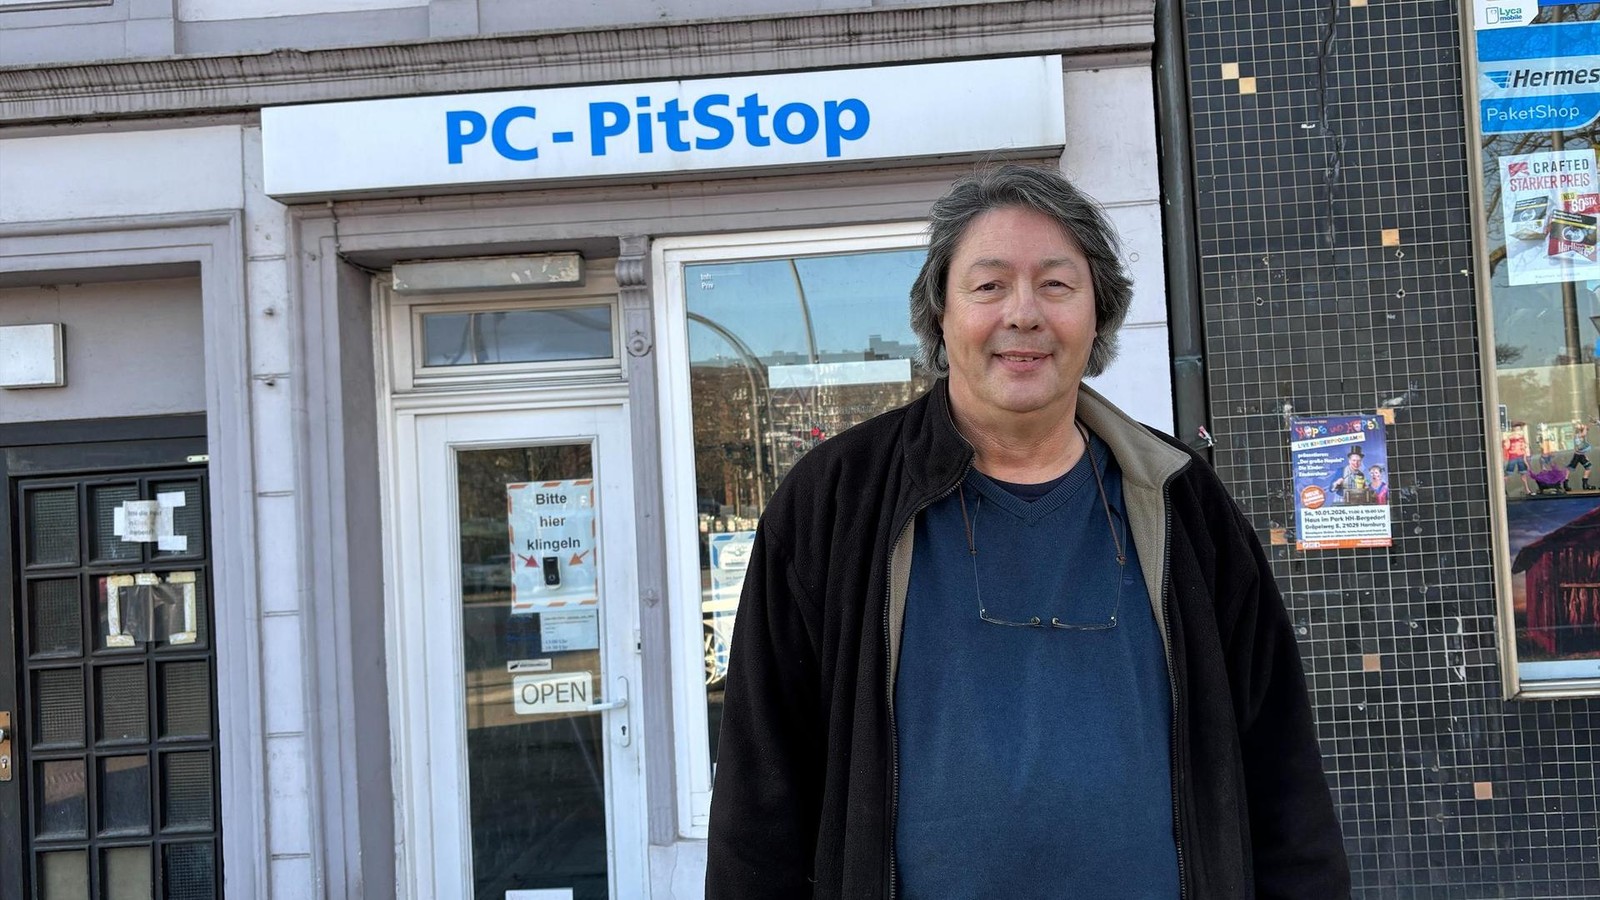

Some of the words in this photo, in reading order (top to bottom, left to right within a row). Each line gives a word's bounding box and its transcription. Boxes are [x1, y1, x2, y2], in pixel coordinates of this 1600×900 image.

[1500, 8, 1522, 16] Lyca
[1513, 68, 1600, 88] Hermes
[1487, 104, 1580, 121] PaketShop
[446, 106, 539, 164] PC
[589, 92, 870, 158] PitStop
[1533, 158, 1589, 174] CRAFTED
[1509, 175, 1558, 192] STARKER
[1559, 172, 1590, 188] PREIS
[1571, 198, 1586, 212] 60
[536, 493, 567, 505] Bitte
[540, 516, 566, 527] hier
[527, 536, 581, 552] klingeln
[521, 681, 587, 706] OPEN
